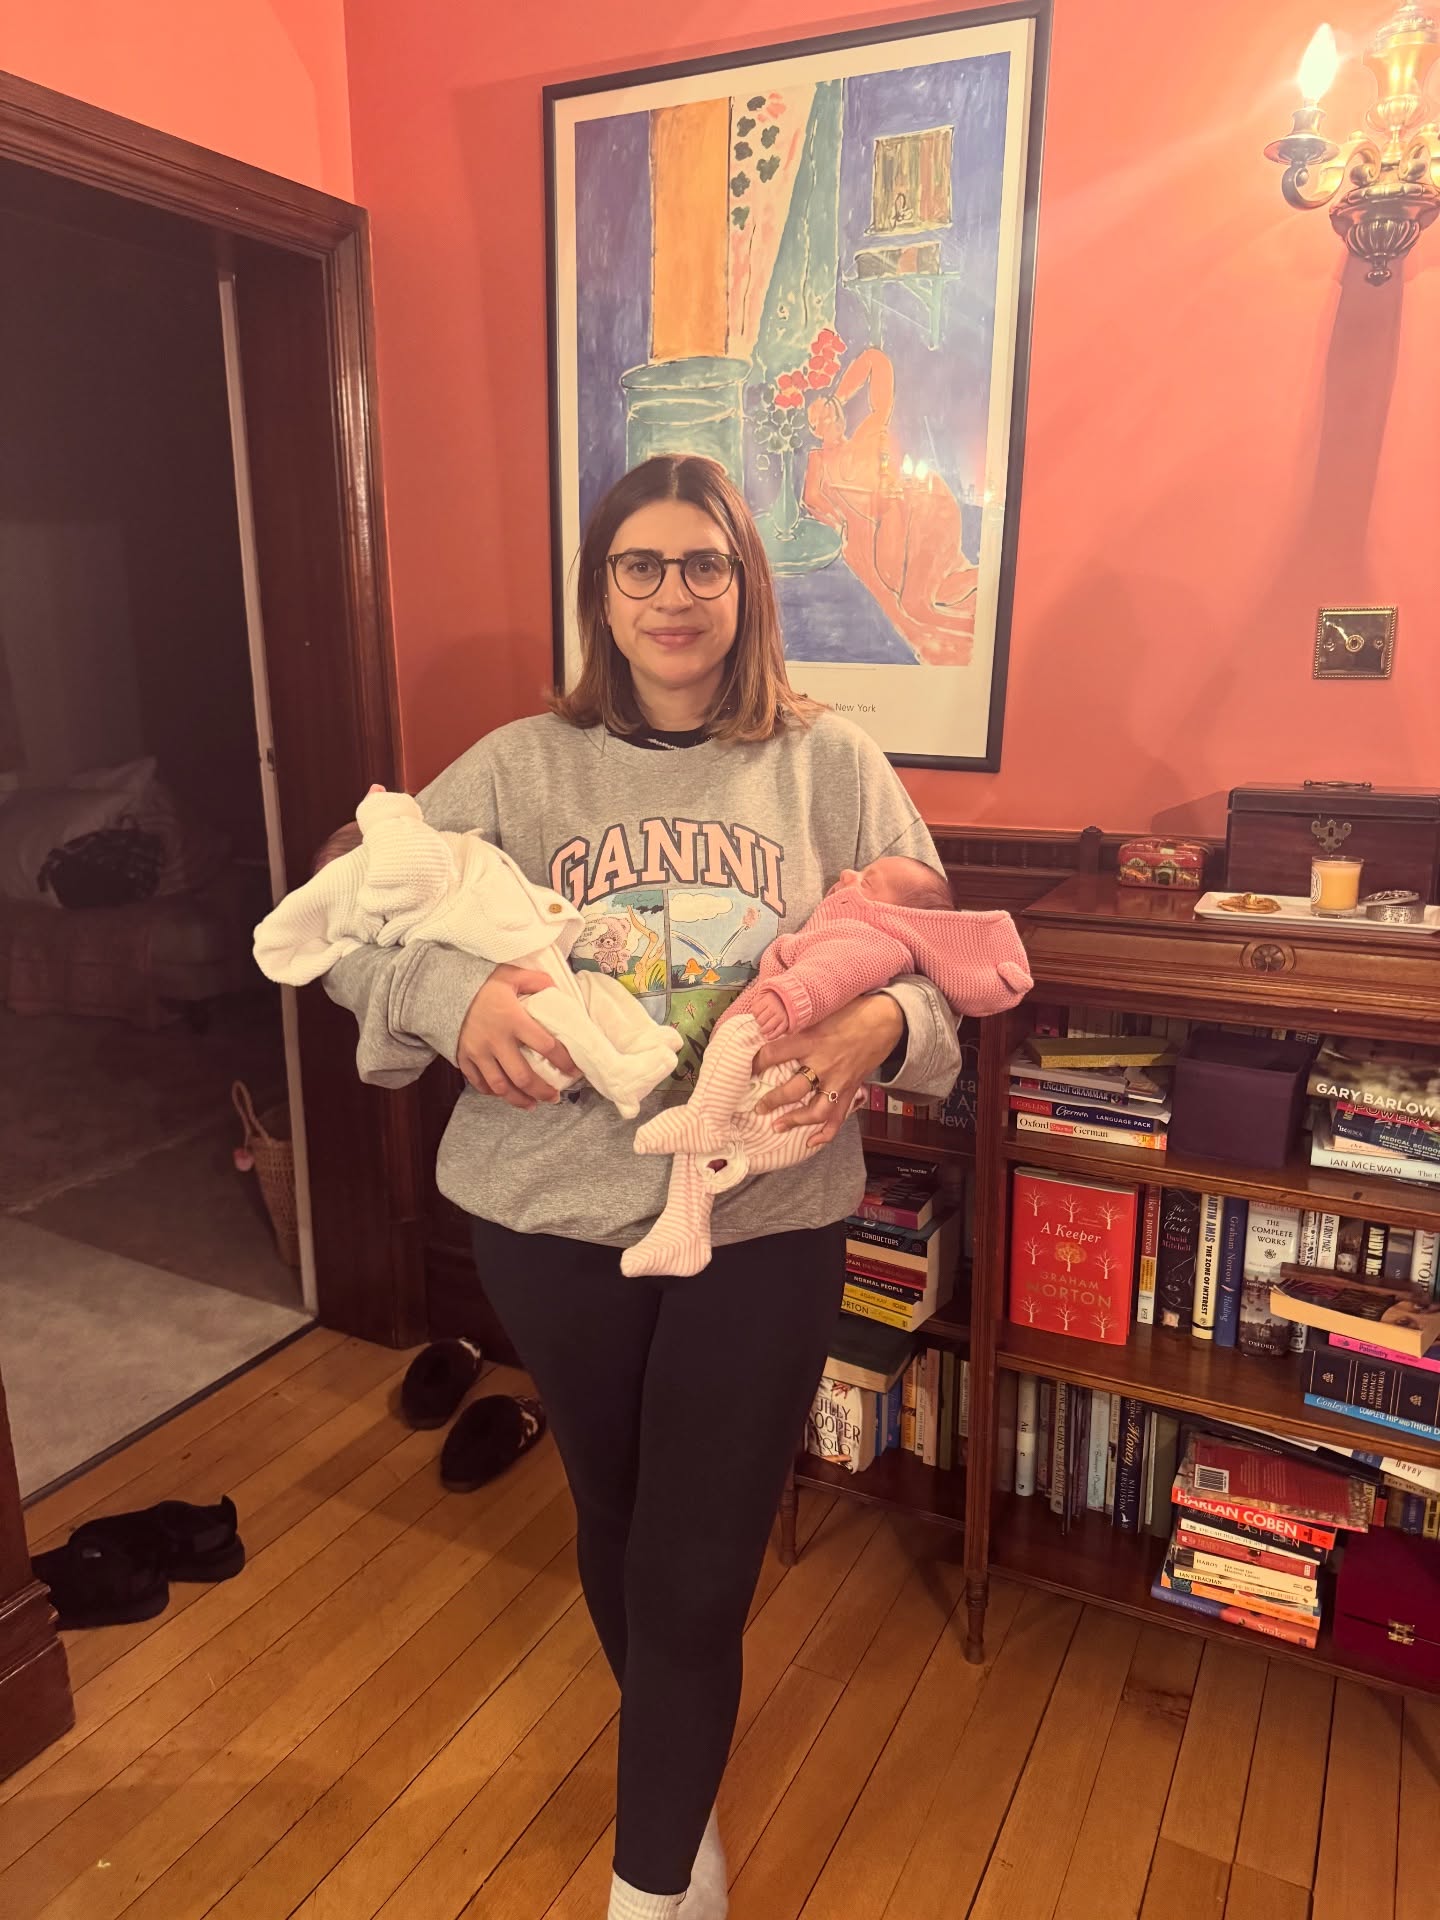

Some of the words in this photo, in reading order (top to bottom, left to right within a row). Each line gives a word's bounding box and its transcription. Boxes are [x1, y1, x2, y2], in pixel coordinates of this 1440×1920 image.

[835, 703, 854, 712] New
[857, 703, 876, 713] York
[549, 816, 786, 918] GANNI
[1316, 1083, 1361, 1101] GARY
[1363, 1093, 1437, 1118] BARLOW
[1016, 1101, 1049, 1112] COLLINS
[1055, 1105, 1089, 1119] German
[1096, 1114, 1132, 1125] LANGUAGE
[1133, 1120, 1151, 1128] PACK
[1019, 1118, 1049, 1130] Oxford
[1073, 1126, 1109, 1138] German
[1379, 1134, 1410, 1147] MEDICAL
[1330, 1158, 1348, 1168] IAN
[1351, 1160, 1402, 1175] MCEWAN
[1041, 1222, 1051, 1234] A
[1055, 1223, 1102, 1244] Keeper
[1164, 1221, 1190, 1233] Clocks
[1205, 1221, 1216, 1243] AMIS
[1228, 1216, 1238, 1249] Graham
[1251, 1226, 1294, 1238] COMPLETE
[1265, 1219, 1280, 1227] THE
[862, 1232, 899, 1246] CONDUCTORS
[1162, 1240, 1191, 1251] Mitchell
[1257, 1235, 1286, 1247] WORKS
[1367, 1227, 1385, 1256] ANDY
[1225, 1253, 1236, 1282] Norton
[853, 1276, 880, 1288] NORMAL
[880, 1283, 904, 1294] PEOPLE
[1040, 1272, 1100, 1290] GRAHAM
[1203, 1277, 1210, 1285] OF
[1026, 1282, 1112, 1309] NORTON
[1201, 1285, 1209, 1315] INTEREST
[1219, 1295, 1232, 1322] Holding
[1248, 1340, 1275, 1350] OXFORD
[1360, 1372, 1369, 1400] OXFORD
[1368, 1371, 1377, 1404] COMPACT
[1375, 1370, 1386, 1409] THESAURUS
[818, 1399, 851, 1420] JILLY
[1316, 1396, 1349, 1413] Conley's
[1360, 1407, 1385, 1420] COMPLETE
[1386, 1413, 1399, 1423] HIP
[1410, 1420, 1432, 1433] THIGH
[819, 1436, 851, 1455] POLO
[1057, 1426, 1065, 1451] GIRLS
[1123, 1418, 1140, 1466] Money
[1119, 1467, 1129, 1511] FERGUSON
[1127, 1479, 1135, 1502] NIALL
[1177, 1490, 1240, 1519] HARLAN
[1243, 1510, 1298, 1537] COBEN
[1179, 1571, 1190, 1580] IAN
[1190, 1574, 1223, 1586] STRACHAN
[1257, 1623, 1287, 1640] Snake
